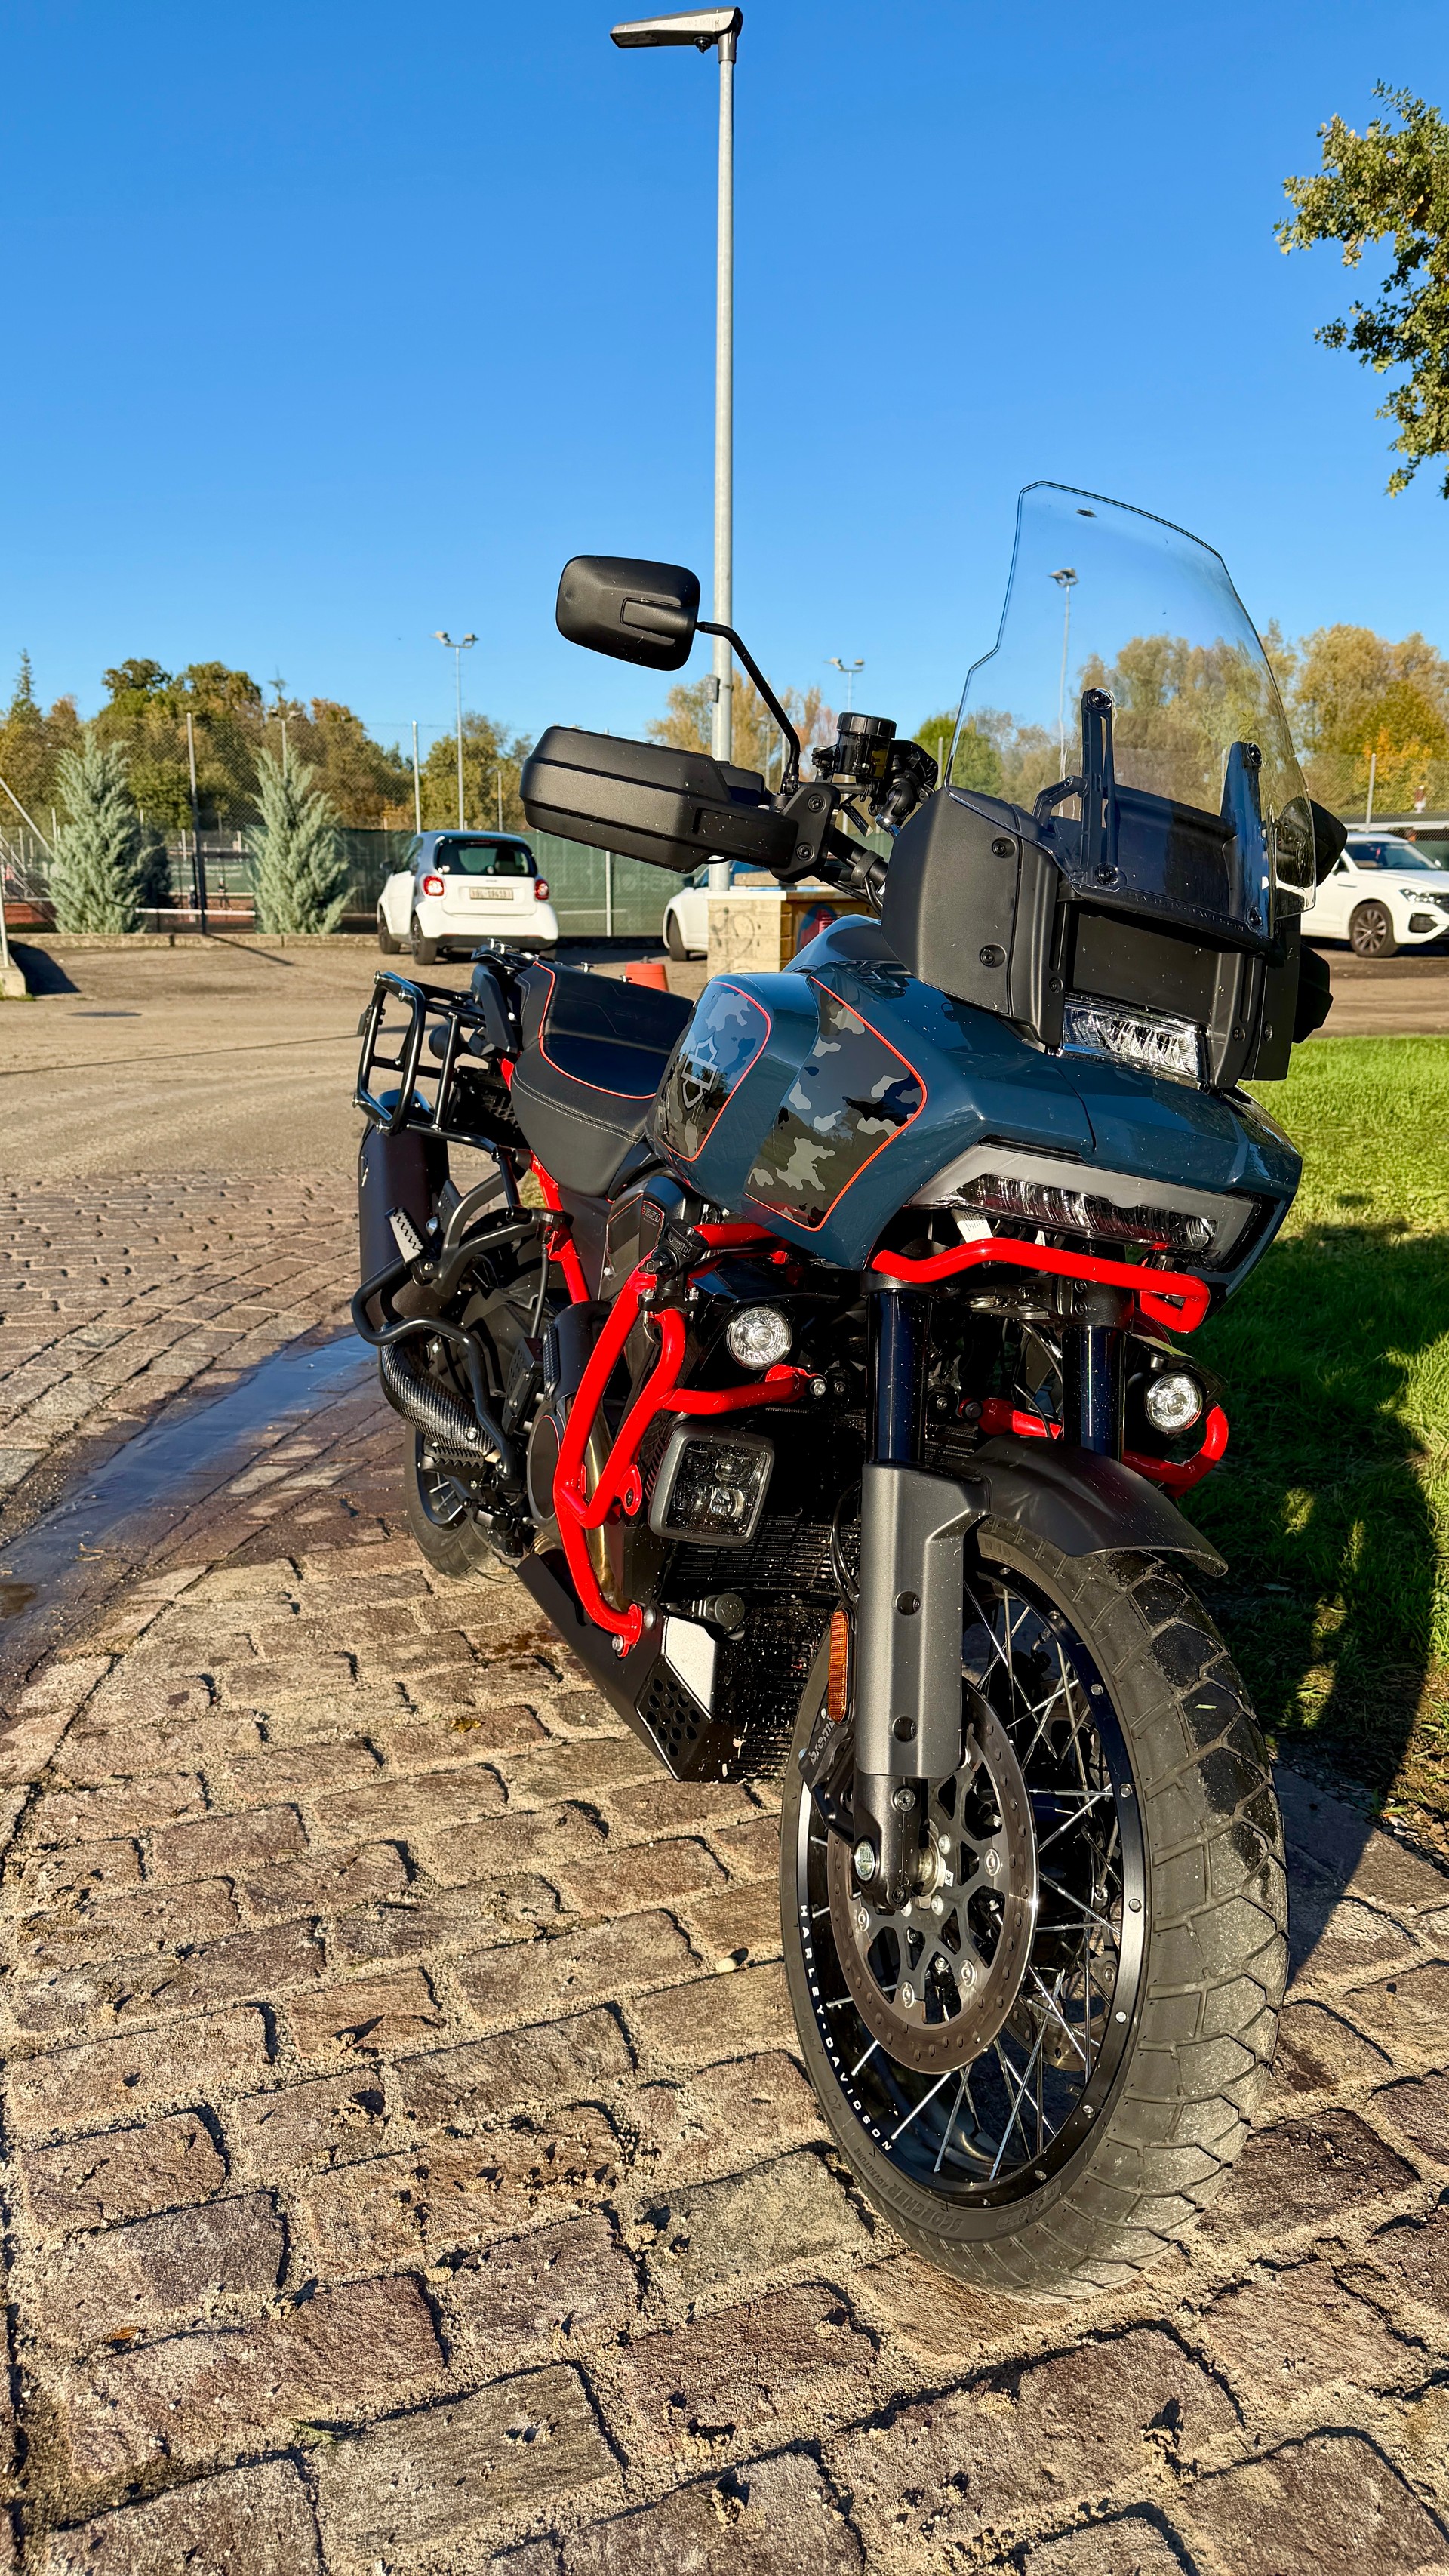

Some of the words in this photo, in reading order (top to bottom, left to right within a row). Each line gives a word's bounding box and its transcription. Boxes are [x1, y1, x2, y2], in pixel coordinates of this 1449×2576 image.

[808, 1714, 835, 1765] brem
[800, 1904, 893, 2151] HARLEY-DAVIDSON
[854, 2147, 889, 2190] ADVENTURE
[888, 2182, 964, 2233] SCORCHER
